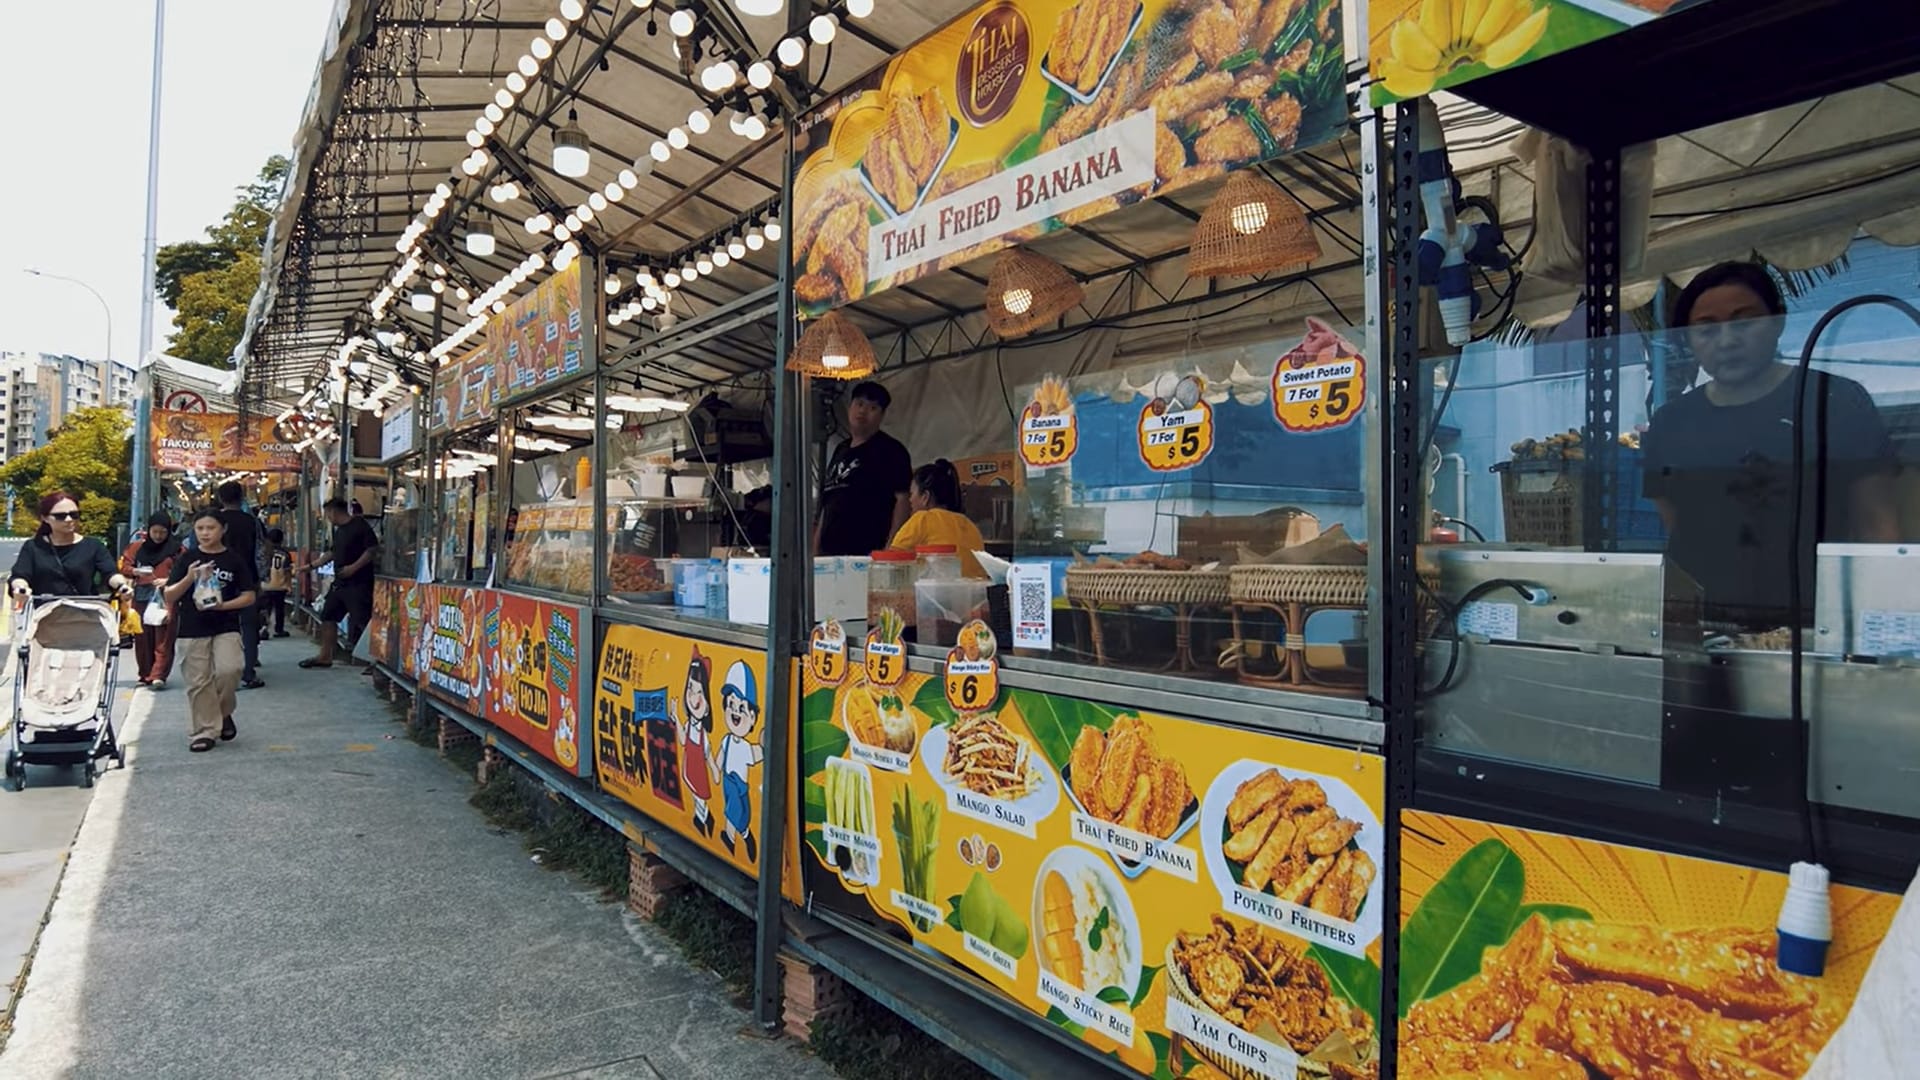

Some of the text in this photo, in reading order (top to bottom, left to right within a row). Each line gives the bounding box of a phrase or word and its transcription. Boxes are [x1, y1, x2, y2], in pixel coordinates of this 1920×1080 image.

[978, 45, 1019, 88] DESSERT
[977, 70, 1005, 101] HOUSE
[882, 146, 1123, 261] THAI FRIED BANANA
[1283, 366, 1351, 383] Sweet Potato
[1289, 388, 1319, 401] 7 For
[1325, 381, 1351, 417] 5
[1031, 417, 1062, 428] Banana
[1161, 415, 1185, 427] Yam
[161, 438, 213, 449] TAKOYAKI
[1027, 434, 1046, 443] 7 For
[1050, 431, 1066, 458] 5
[1151, 432, 1175, 444] 7 For
[1180, 425, 1200, 457] 5
[822, 652, 833, 676] 5
[878, 655, 890, 680] 5
[962, 675, 978, 704] 6
[956, 793, 1026, 827] MANGO SALAD
[829, 827, 877, 850] SWEET MANGO
[1076, 818, 1192, 872] THAI FRIED BANANA
[1233, 890, 1356, 947] POTATO FRITTERS
[969, 937, 991, 959] MANGO
[1041, 977, 1131, 1037] MANGO STICKY RICE
[1191, 1014, 1268, 1064] YAM CHIPS
